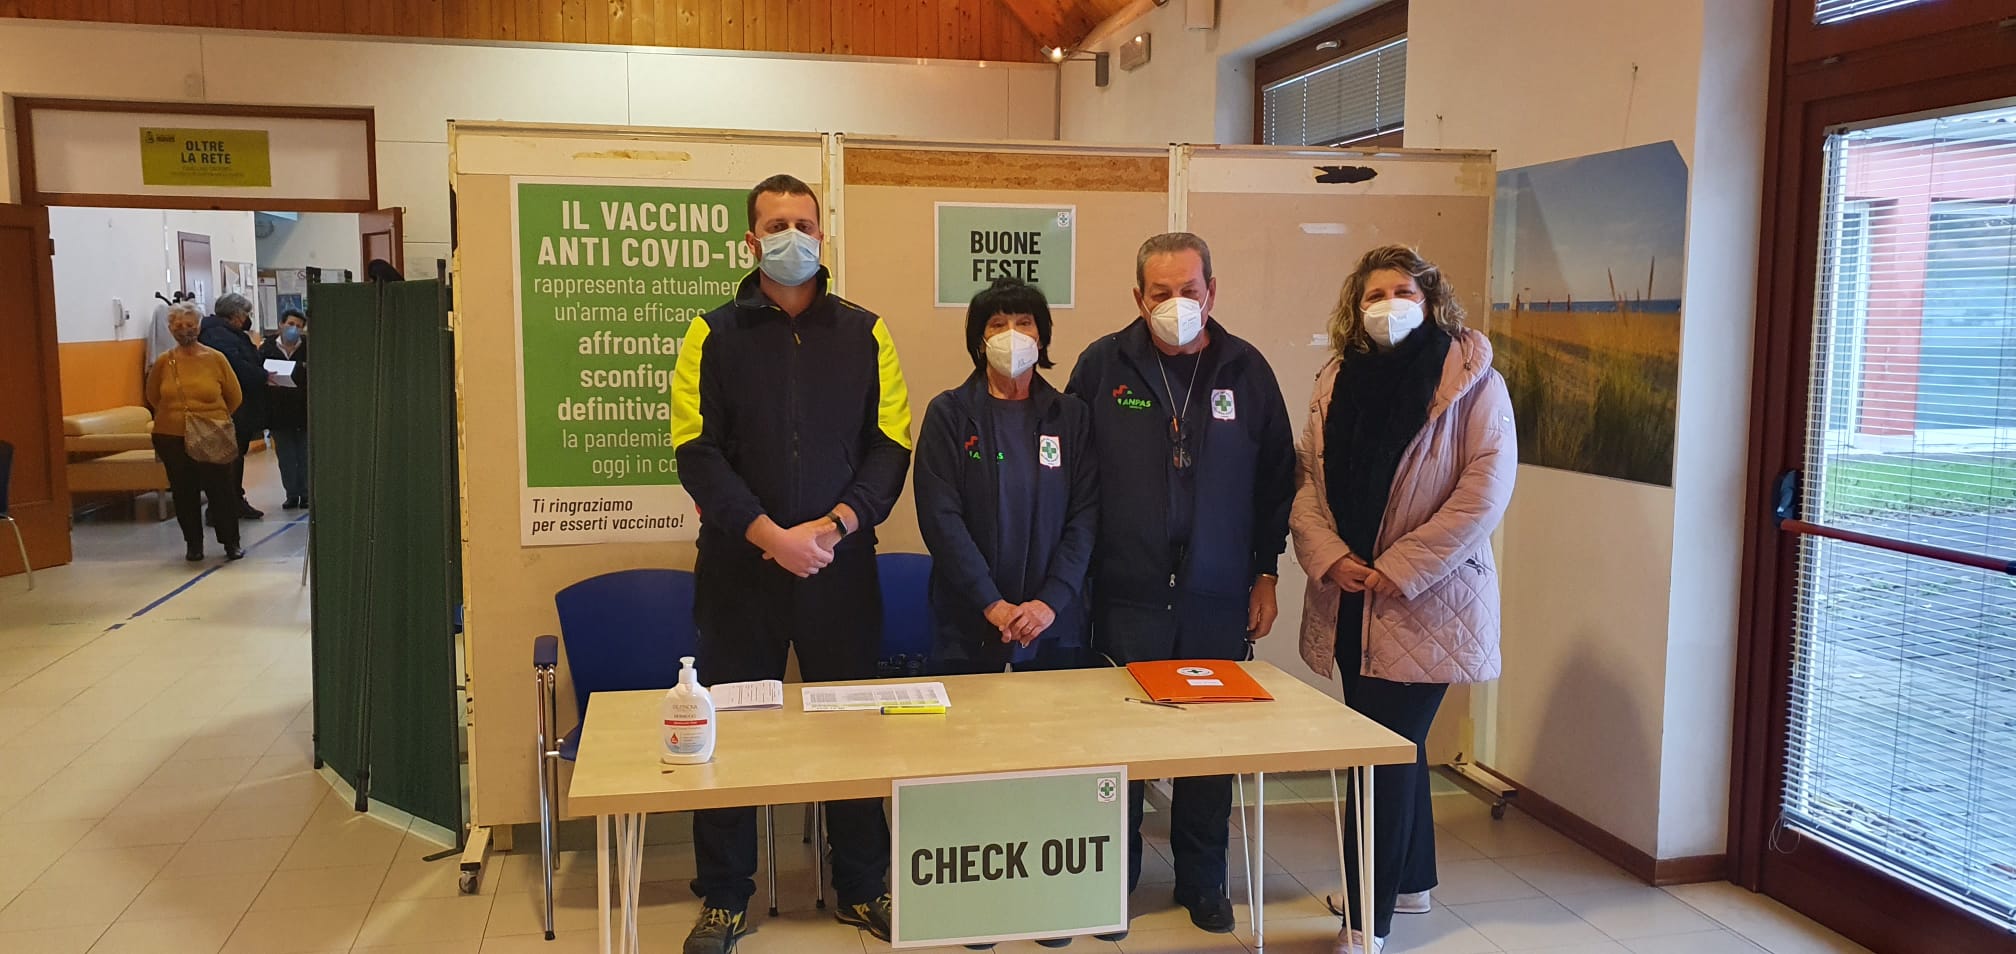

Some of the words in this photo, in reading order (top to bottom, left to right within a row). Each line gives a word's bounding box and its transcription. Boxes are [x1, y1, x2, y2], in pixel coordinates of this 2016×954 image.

[185, 140, 225, 152] OLTRE
[181, 152, 196, 164] LA
[201, 153, 232, 165] RETE
[562, 200, 590, 230] IL
[600, 202, 729, 233] VACCINO
[538, 236, 610, 266] ANTI
[622, 238, 755, 269] COVID-19
[971, 231, 1042, 255] BUONE
[973, 259, 1039, 283] FESTE
[534, 276, 646, 298] rappresenta
[555, 303, 628, 322] un'arma
[558, 396, 670, 421] definitiva
[1122, 398, 1152, 408] ANPAS
[563, 429, 578, 449] la
[585, 428, 673, 453] pandemia
[592, 455, 630, 478] oggi
[637, 454, 652, 473] in
[532, 499, 545, 514] Ti
[549, 498, 633, 517] ringraziamo
[532, 519, 556, 536] per
[560, 516, 608, 533] esserti
[613, 514, 685, 531] vaccinato!
[911, 841, 1029, 886] CHECK
[1041, 835, 1111, 877] OUT
